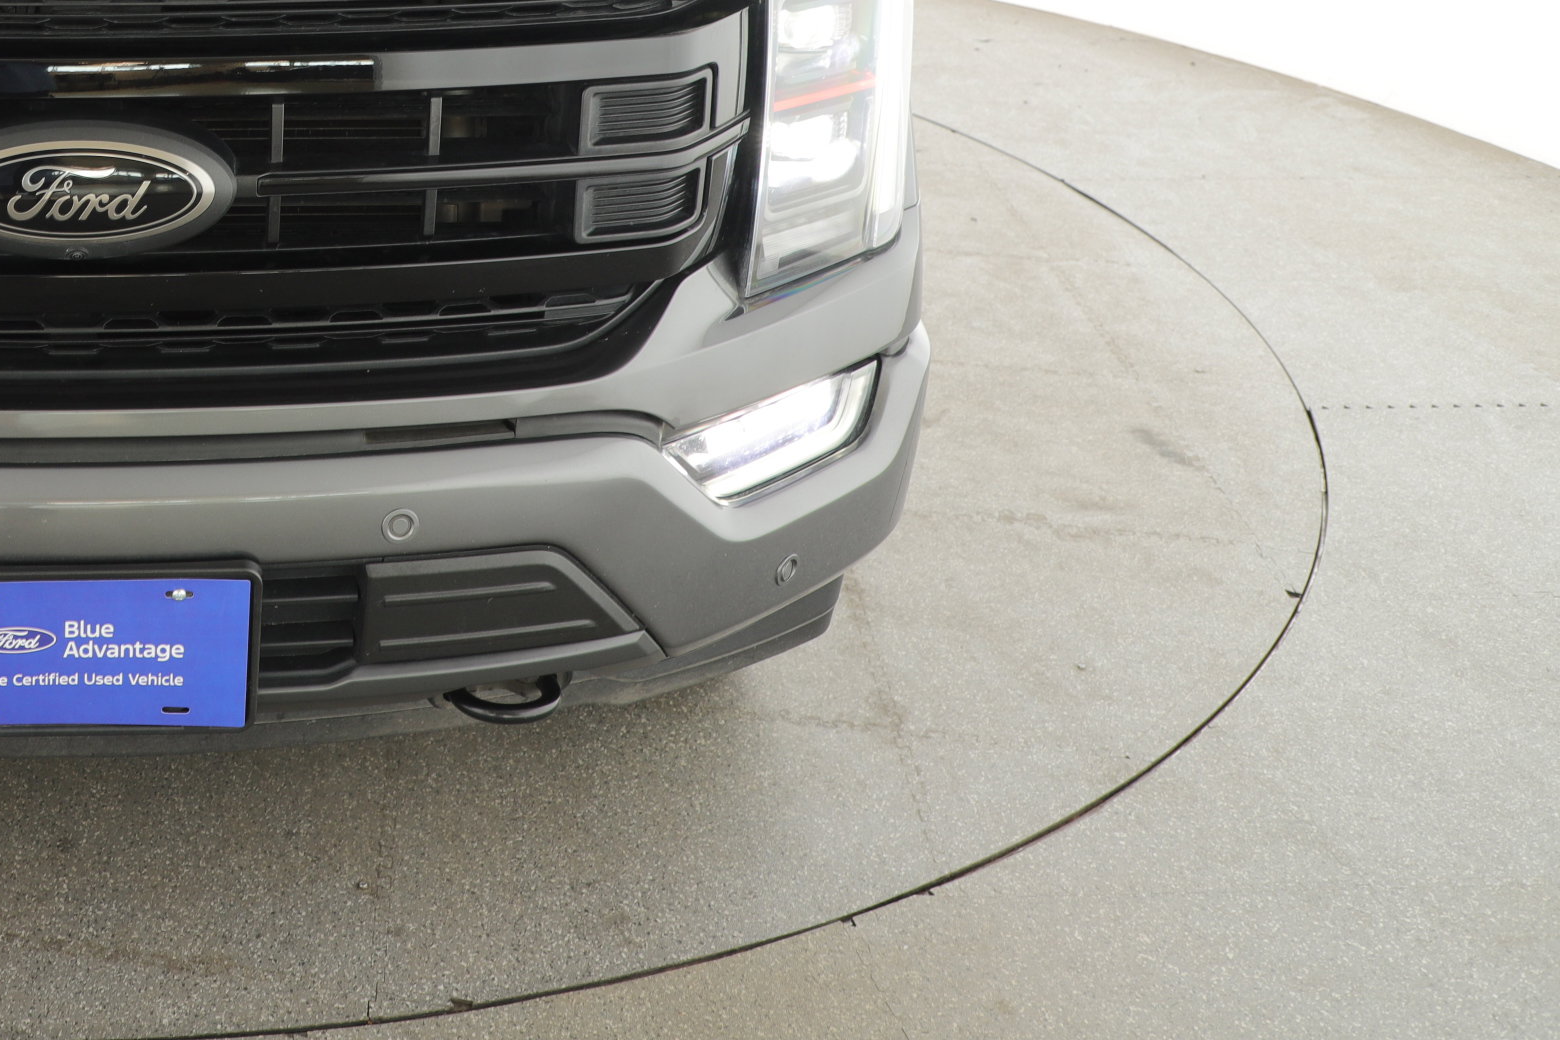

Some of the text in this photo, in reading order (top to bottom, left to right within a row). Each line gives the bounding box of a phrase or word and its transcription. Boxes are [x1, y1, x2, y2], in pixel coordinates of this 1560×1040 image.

[6, 165, 151, 222] Ford
[64, 619, 115, 638] Blue
[63, 640, 185, 662] Advantage
[12, 672, 79, 686] Certified
[84, 672, 123, 686] Used
[128, 672, 184, 687] Vehicle
